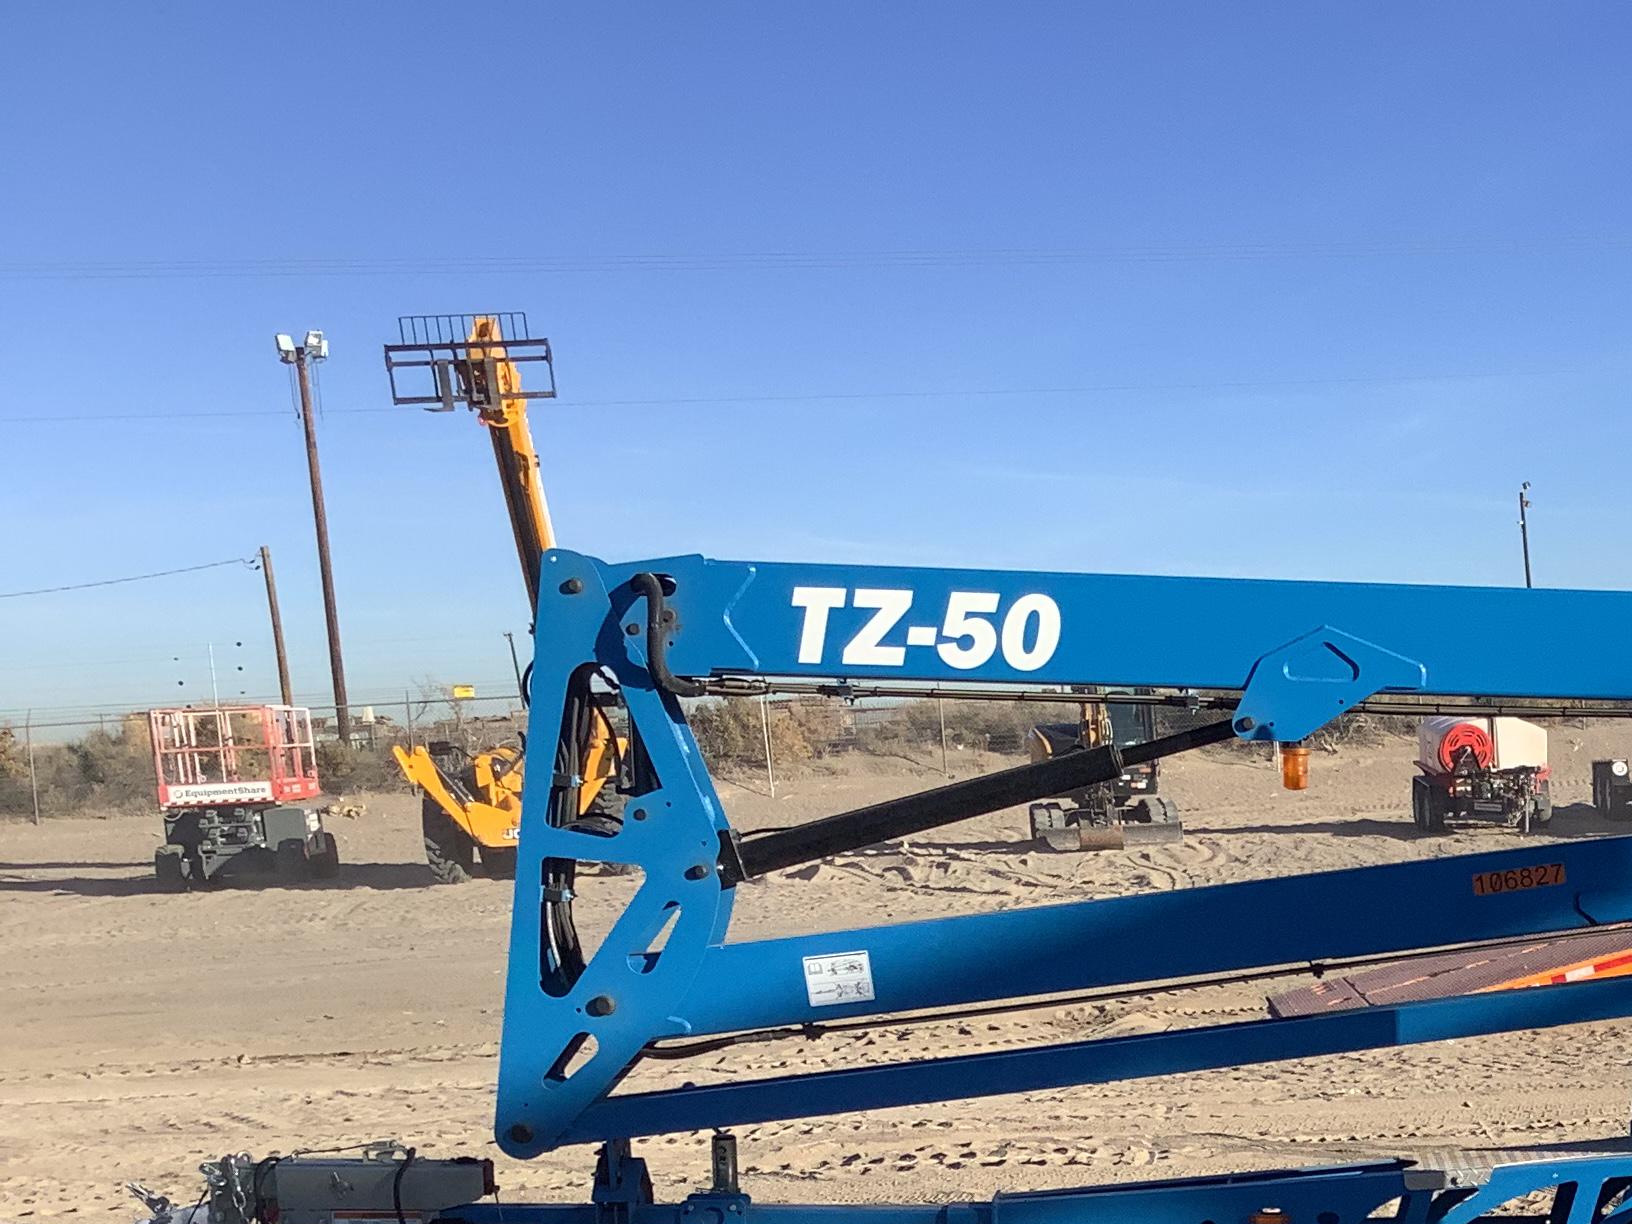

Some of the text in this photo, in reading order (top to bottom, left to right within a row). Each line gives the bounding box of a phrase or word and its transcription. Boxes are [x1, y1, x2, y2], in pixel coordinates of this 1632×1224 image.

[791, 587, 1061, 672] TZ-50
[185, 786, 267, 798] EquipmentShare
[503, 828, 520, 840] JC
[1475, 864, 1562, 893] 106827
